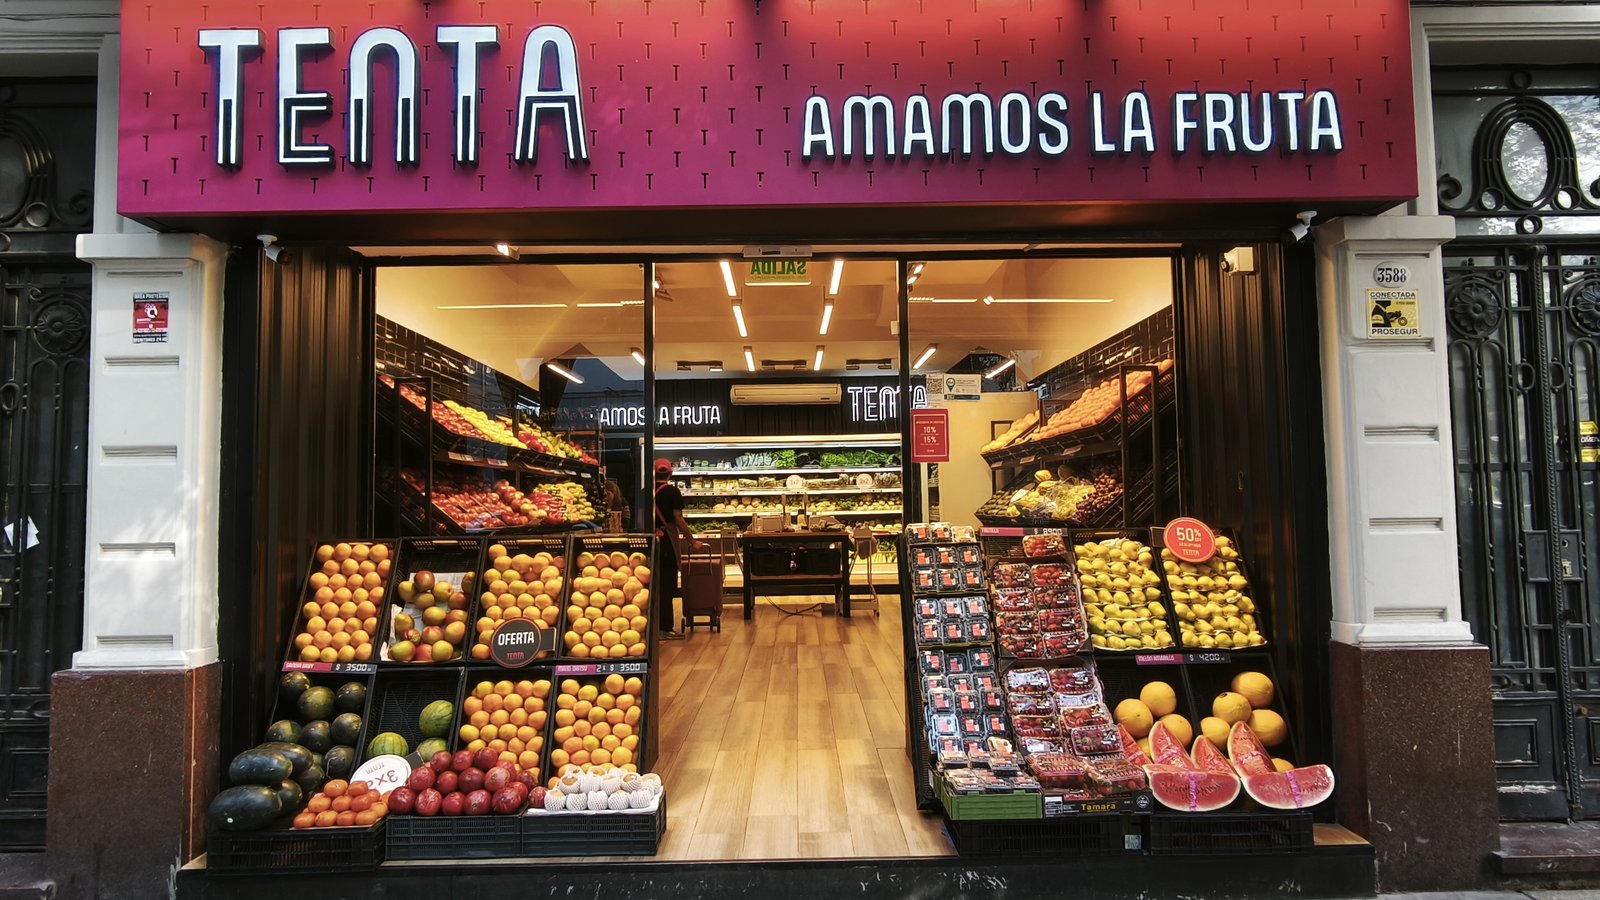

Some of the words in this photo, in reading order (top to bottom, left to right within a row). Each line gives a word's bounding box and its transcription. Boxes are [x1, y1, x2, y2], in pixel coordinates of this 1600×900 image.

[199, 25, 589, 165] TENTA
[803, 92, 1070, 158] AMAMOS
[1092, 90, 1155, 155] LA
[1174, 90, 1343, 153] FRUTA
[1377, 267, 1407, 283] 3588
[599, 406, 646, 426] AMOS
[673, 405, 721, 425] FRUTA
[923, 435, 937, 443] 15%
[1042, 528, 1063, 536] 8900
[1176, 527, 1202, 542] 50%
[497, 631, 535, 646] OFERTA
[506, 651, 525, 660] TENTA
[1198, 653, 1221, 662] 4200
[345, 663, 368, 671] 3500
[619, 663, 641, 672] 3500
[1080, 803, 1117, 811] Tamara
